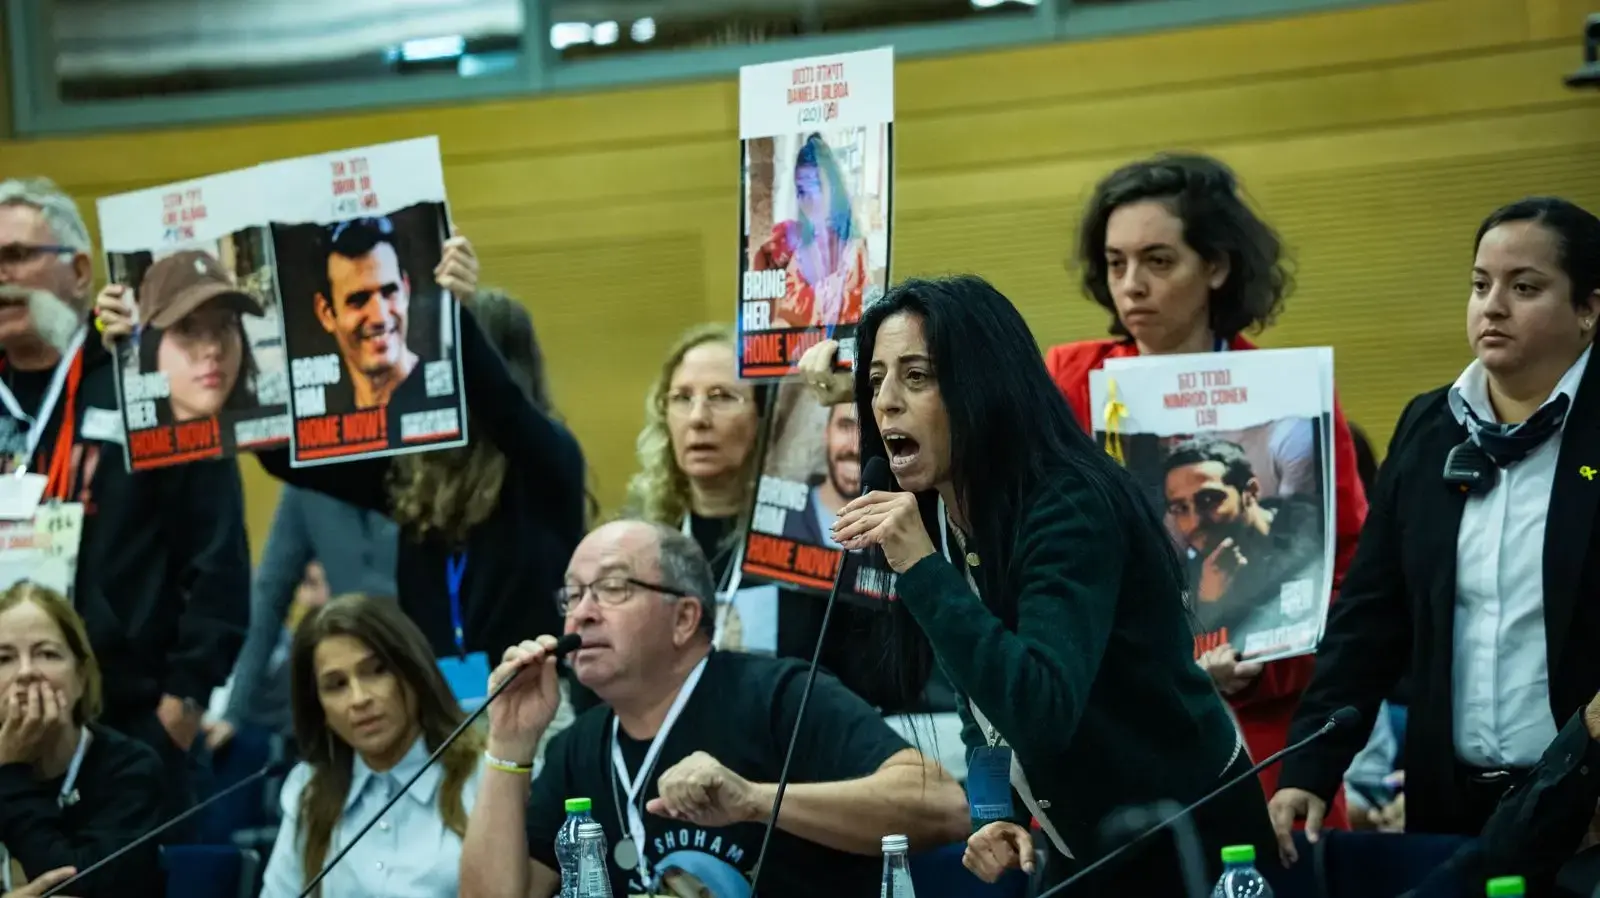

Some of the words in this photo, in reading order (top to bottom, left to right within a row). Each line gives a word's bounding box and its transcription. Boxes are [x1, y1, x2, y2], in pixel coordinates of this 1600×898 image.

[743, 269, 787, 300] BRING
[743, 300, 771, 331] HER
[743, 332, 784, 365] HOME
[291, 353, 341, 388] BRING
[1163, 391, 1207, 409] NIMROD
[1211, 387, 1247, 406] COHEN
[130, 426, 173, 459] HOME
[175, 415, 220, 453] NOW!
[297, 415, 341, 448] HOME
[343, 404, 388, 443] NOW!
[747, 533, 797, 568] HOME
[654, 828, 744, 863] SHOHAM
